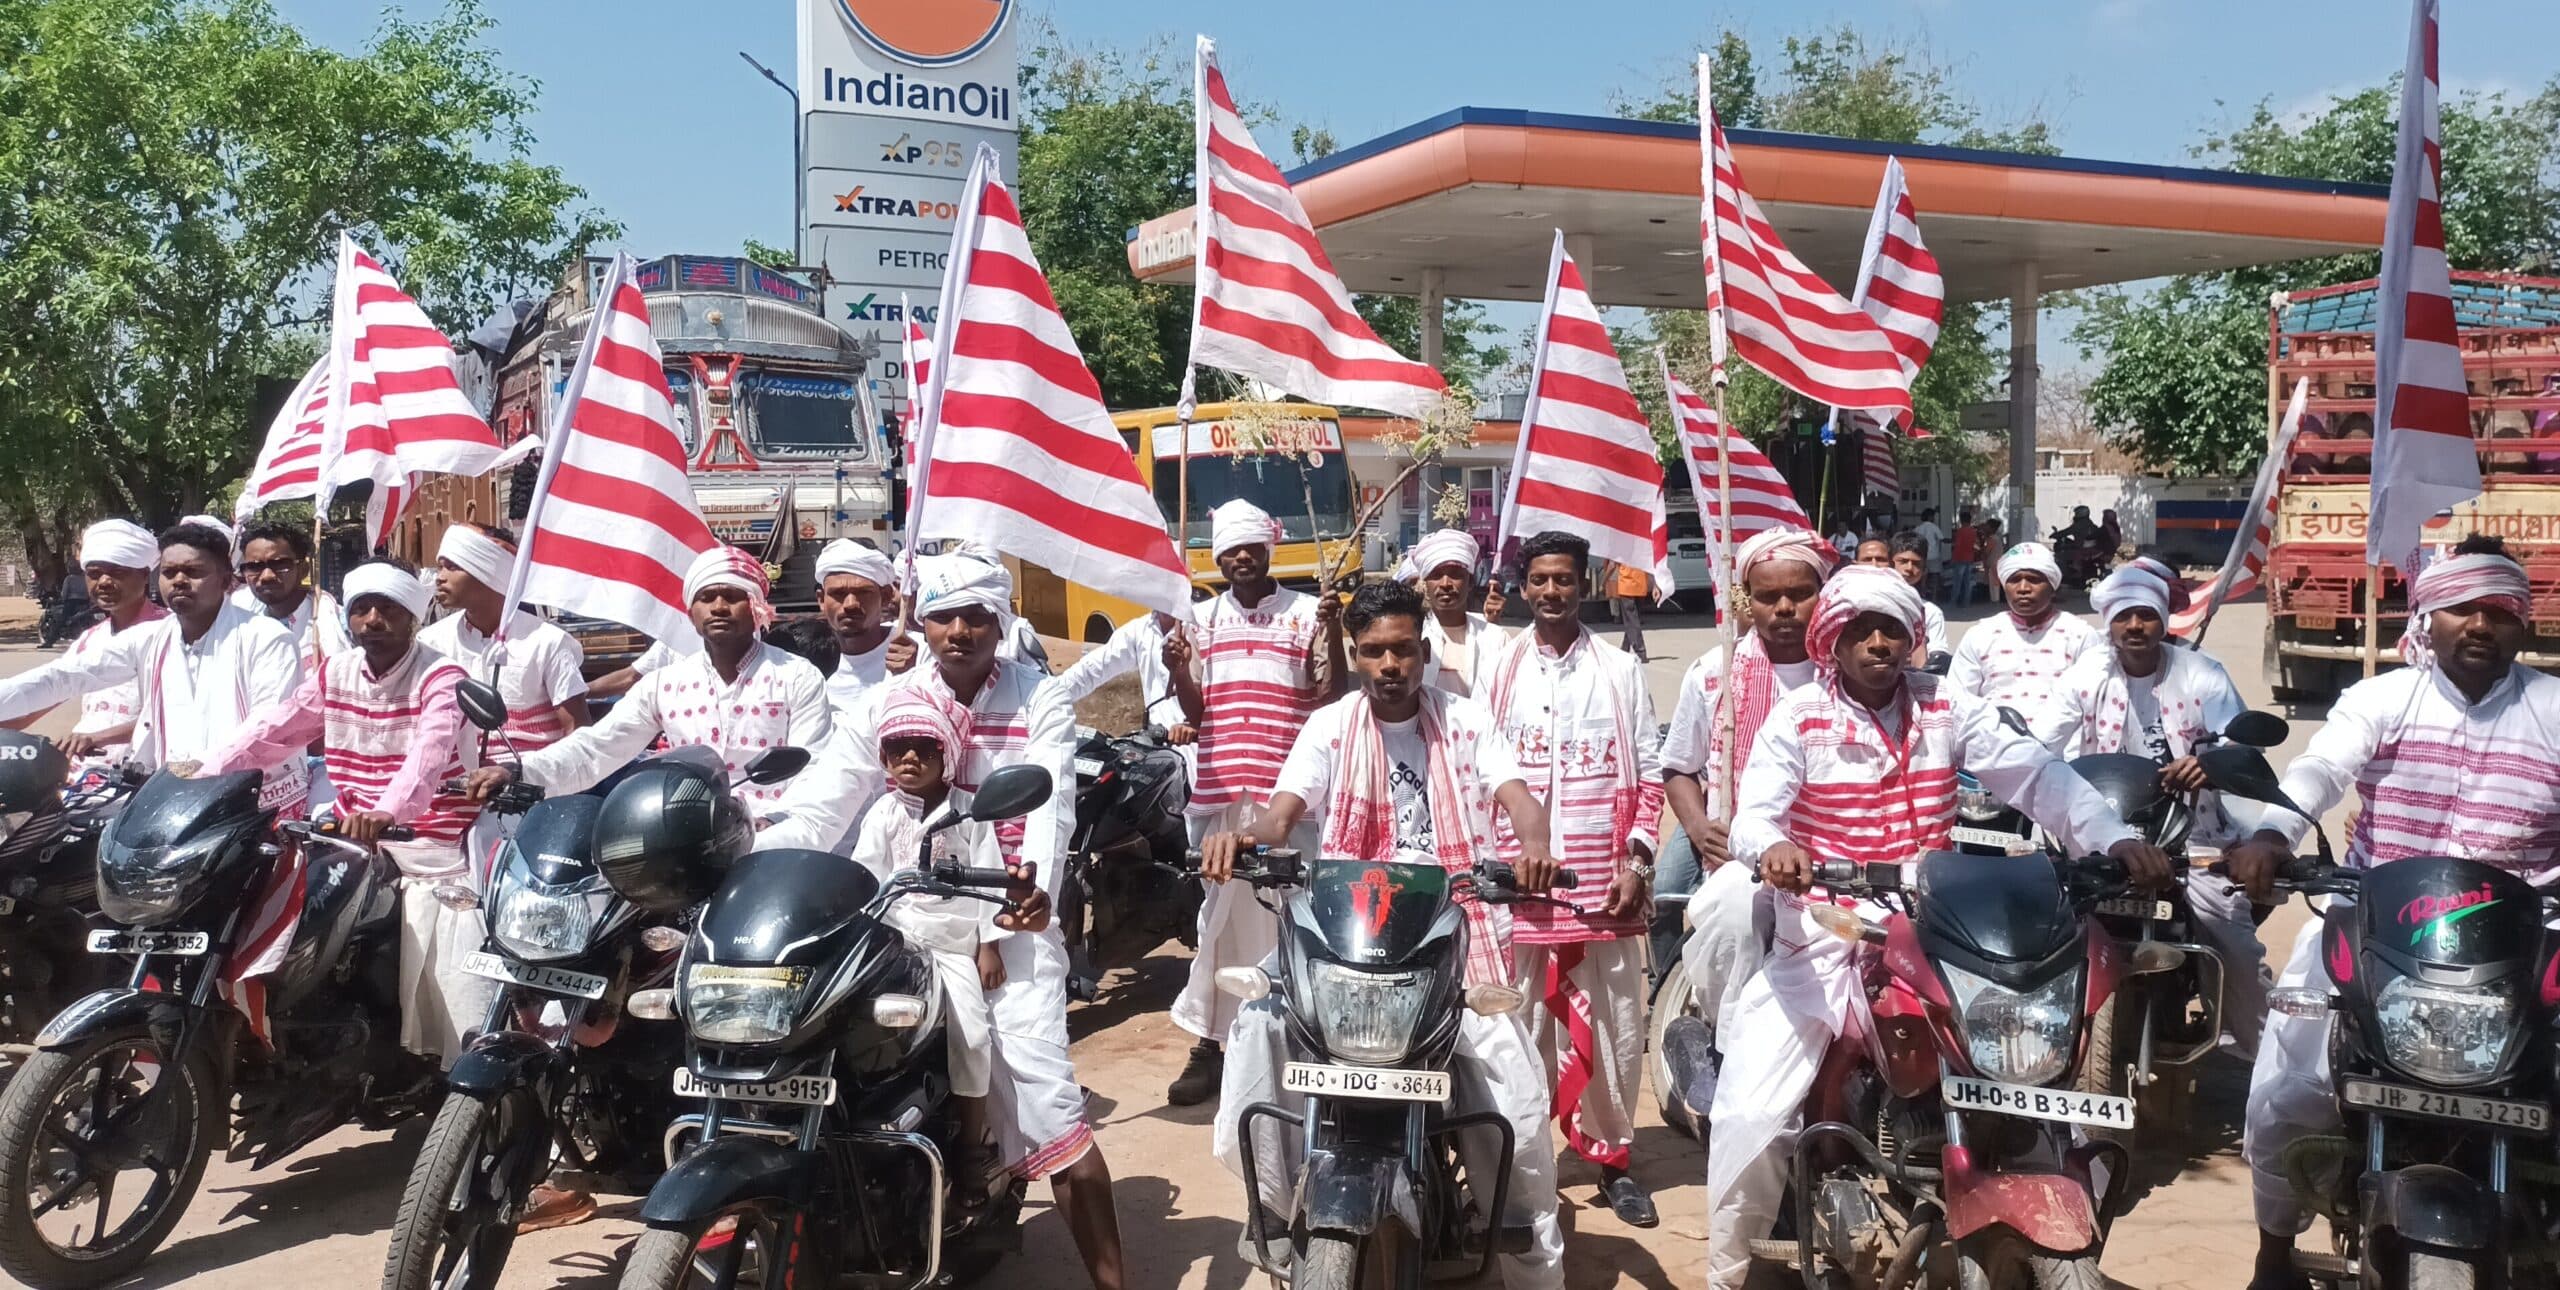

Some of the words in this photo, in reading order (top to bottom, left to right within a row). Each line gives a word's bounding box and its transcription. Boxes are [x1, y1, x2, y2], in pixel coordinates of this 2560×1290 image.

[824, 67, 1009, 120] IndianOil
[537, 853, 583, 867] HONDA
[789, 1079, 831, 1100] 9151
[1402, 1076, 1443, 1096] 3644
[2376, 1087, 2400, 1107] JH
[2419, 1093, 2461, 1117] 23A
[2481, 1102, 2541, 1127] 3239
